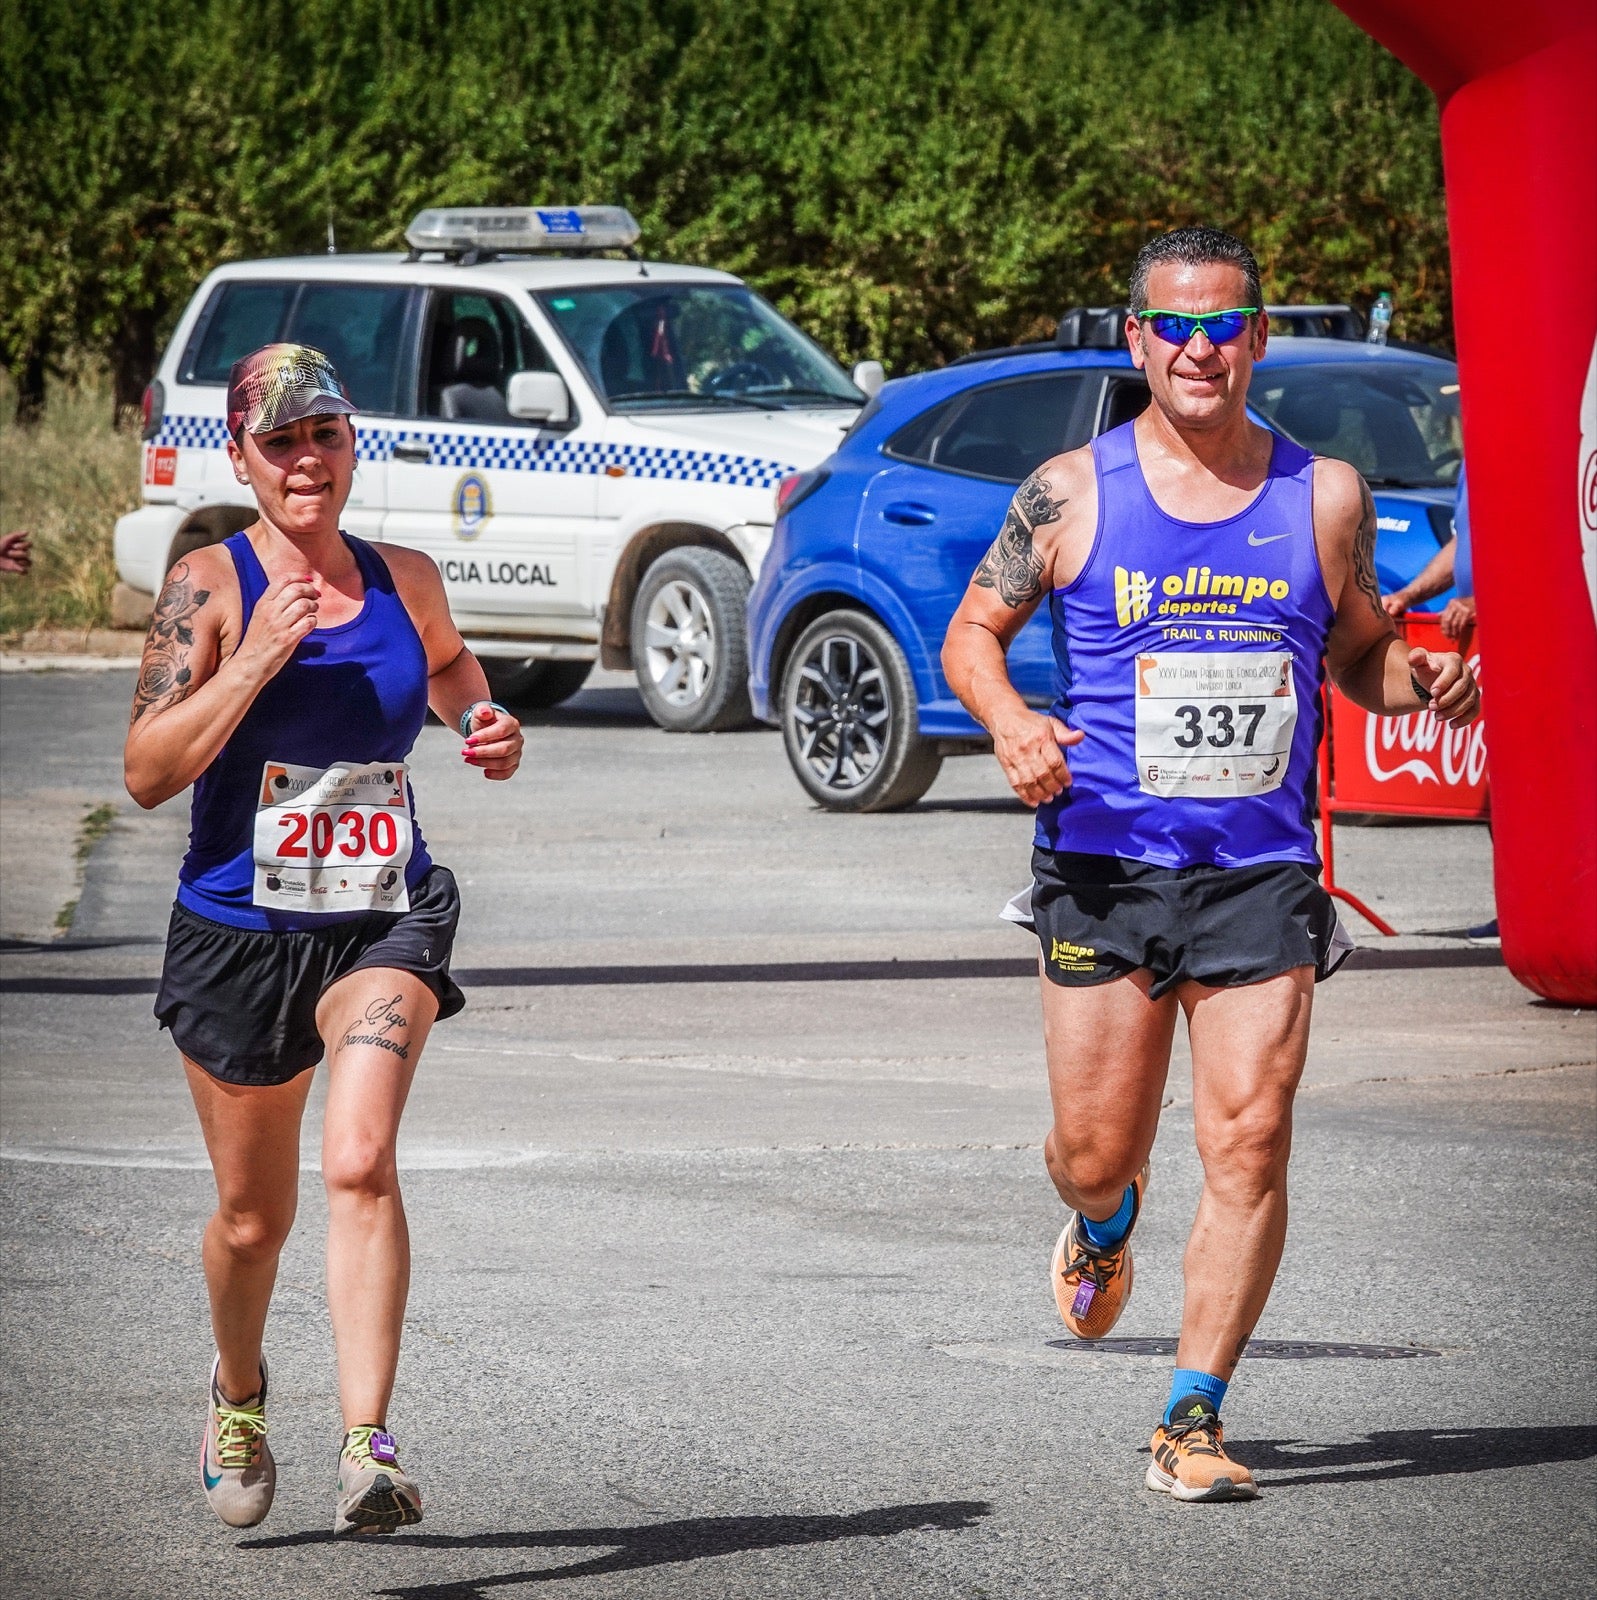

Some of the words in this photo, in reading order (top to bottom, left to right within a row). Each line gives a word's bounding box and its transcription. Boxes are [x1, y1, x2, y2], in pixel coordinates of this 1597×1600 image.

[440, 561, 482, 584] ICIA
[487, 562, 557, 585] LOCAL
[1162, 566, 1290, 604] olimpo
[1158, 599, 1237, 616] deportes
[1162, 628, 1202, 641] TRAIL
[1205, 629, 1215, 641] &
[1219, 629, 1282, 642] RUNNING
[1158, 667, 1177, 679] XXXV
[1259, 666, 1277, 678] 2022
[1174, 704, 1266, 749] 337
[276, 811, 397, 859] 2030
[1059, 941, 1095, 958] olimpo
[365, 994, 407, 1036] Sigo
